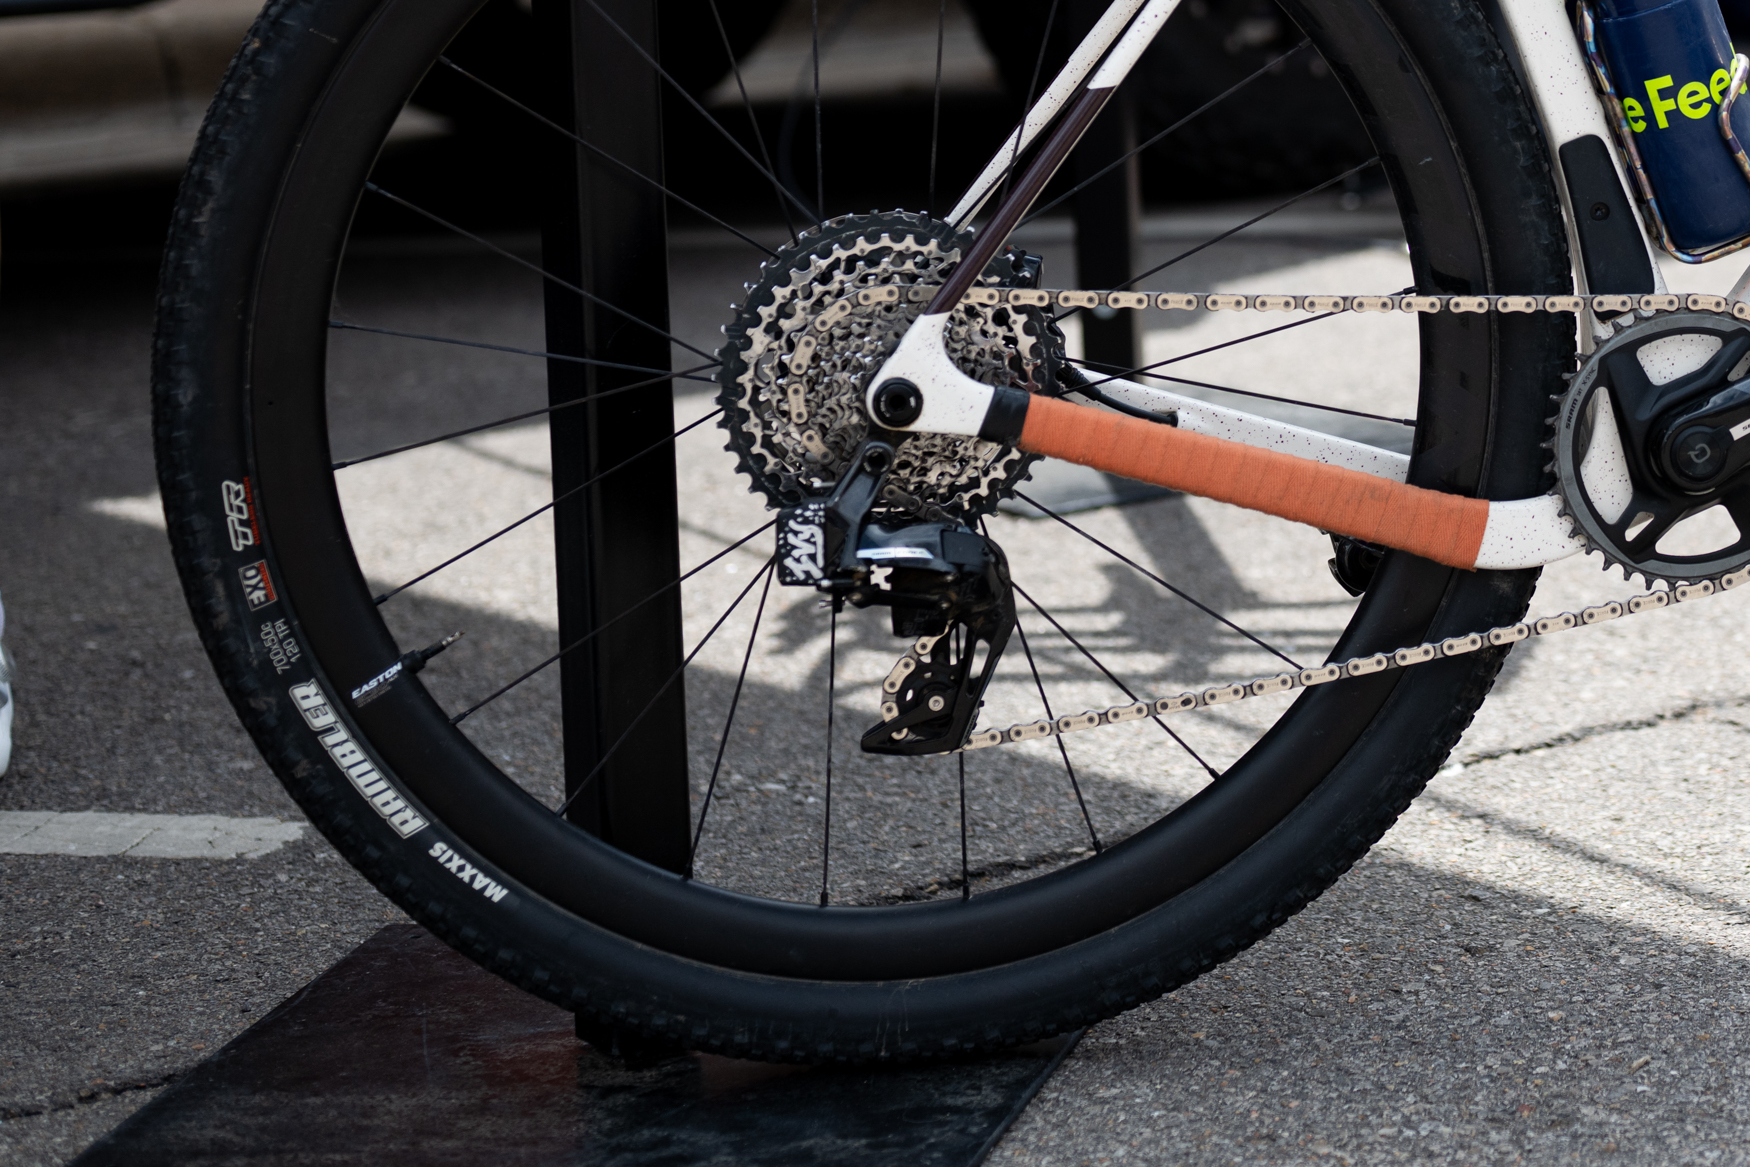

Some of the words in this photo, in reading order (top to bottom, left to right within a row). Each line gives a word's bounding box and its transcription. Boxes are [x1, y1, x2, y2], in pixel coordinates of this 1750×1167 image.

[1565, 398, 1578, 430] SRAM
[221, 479, 254, 552] TR
[243, 564, 268, 607] EXO
[260, 620, 292, 676] 700x50c
[282, 638, 302, 663] 120
[352, 661, 403, 700] EASTON
[288, 677, 430, 840] RAMBLER
[428, 841, 509, 904] MAXXIS
